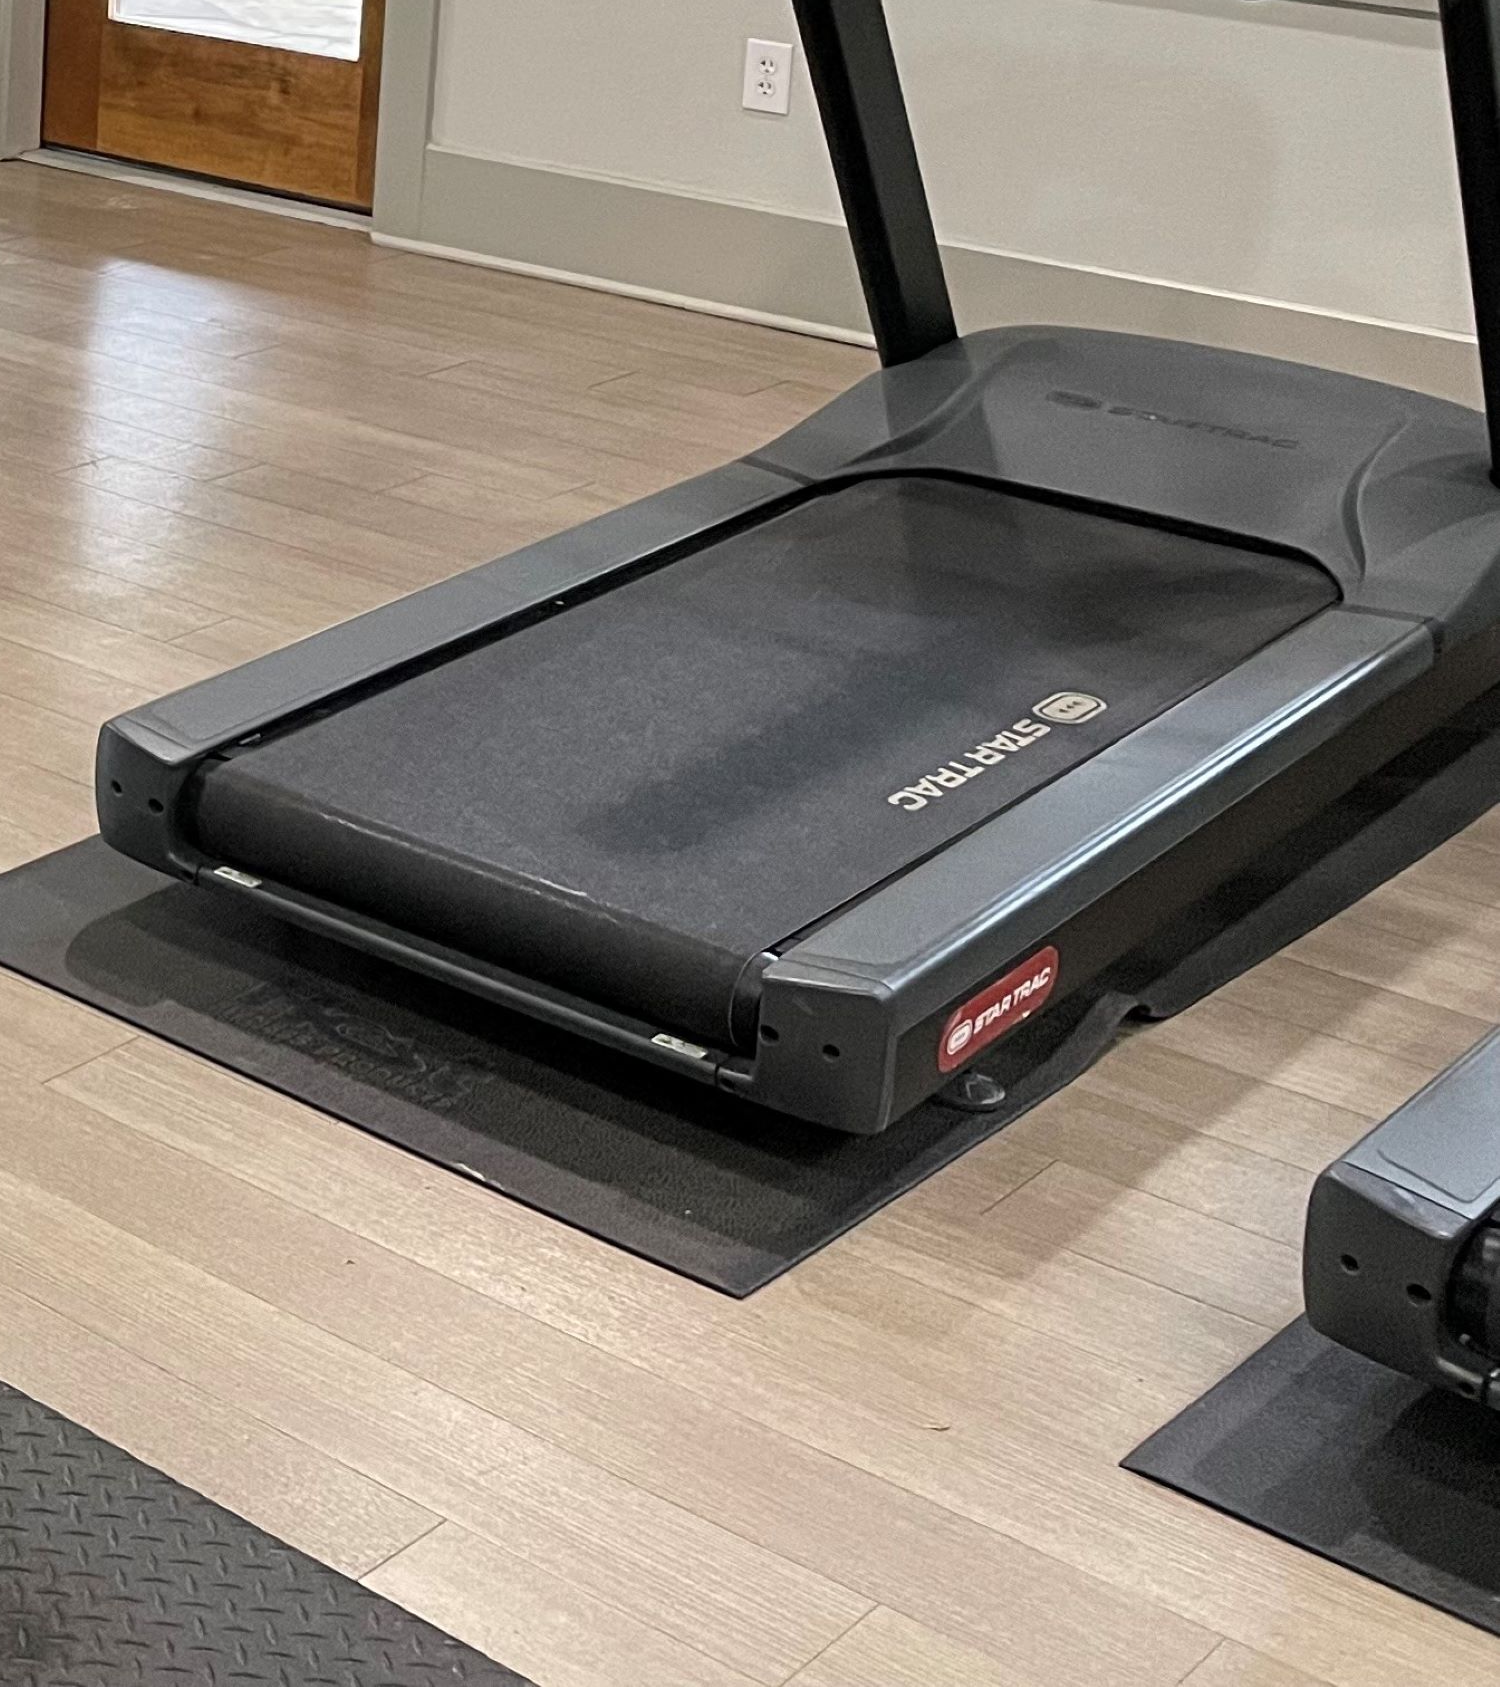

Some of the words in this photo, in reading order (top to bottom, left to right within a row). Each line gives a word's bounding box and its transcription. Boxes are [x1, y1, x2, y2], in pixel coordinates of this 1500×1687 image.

[963, 718, 1052, 765] STAR
[887, 761, 986, 811] TRAC
[973, 994, 1012, 1034] STAR
[1013, 967, 1051, 1006] TRAC
